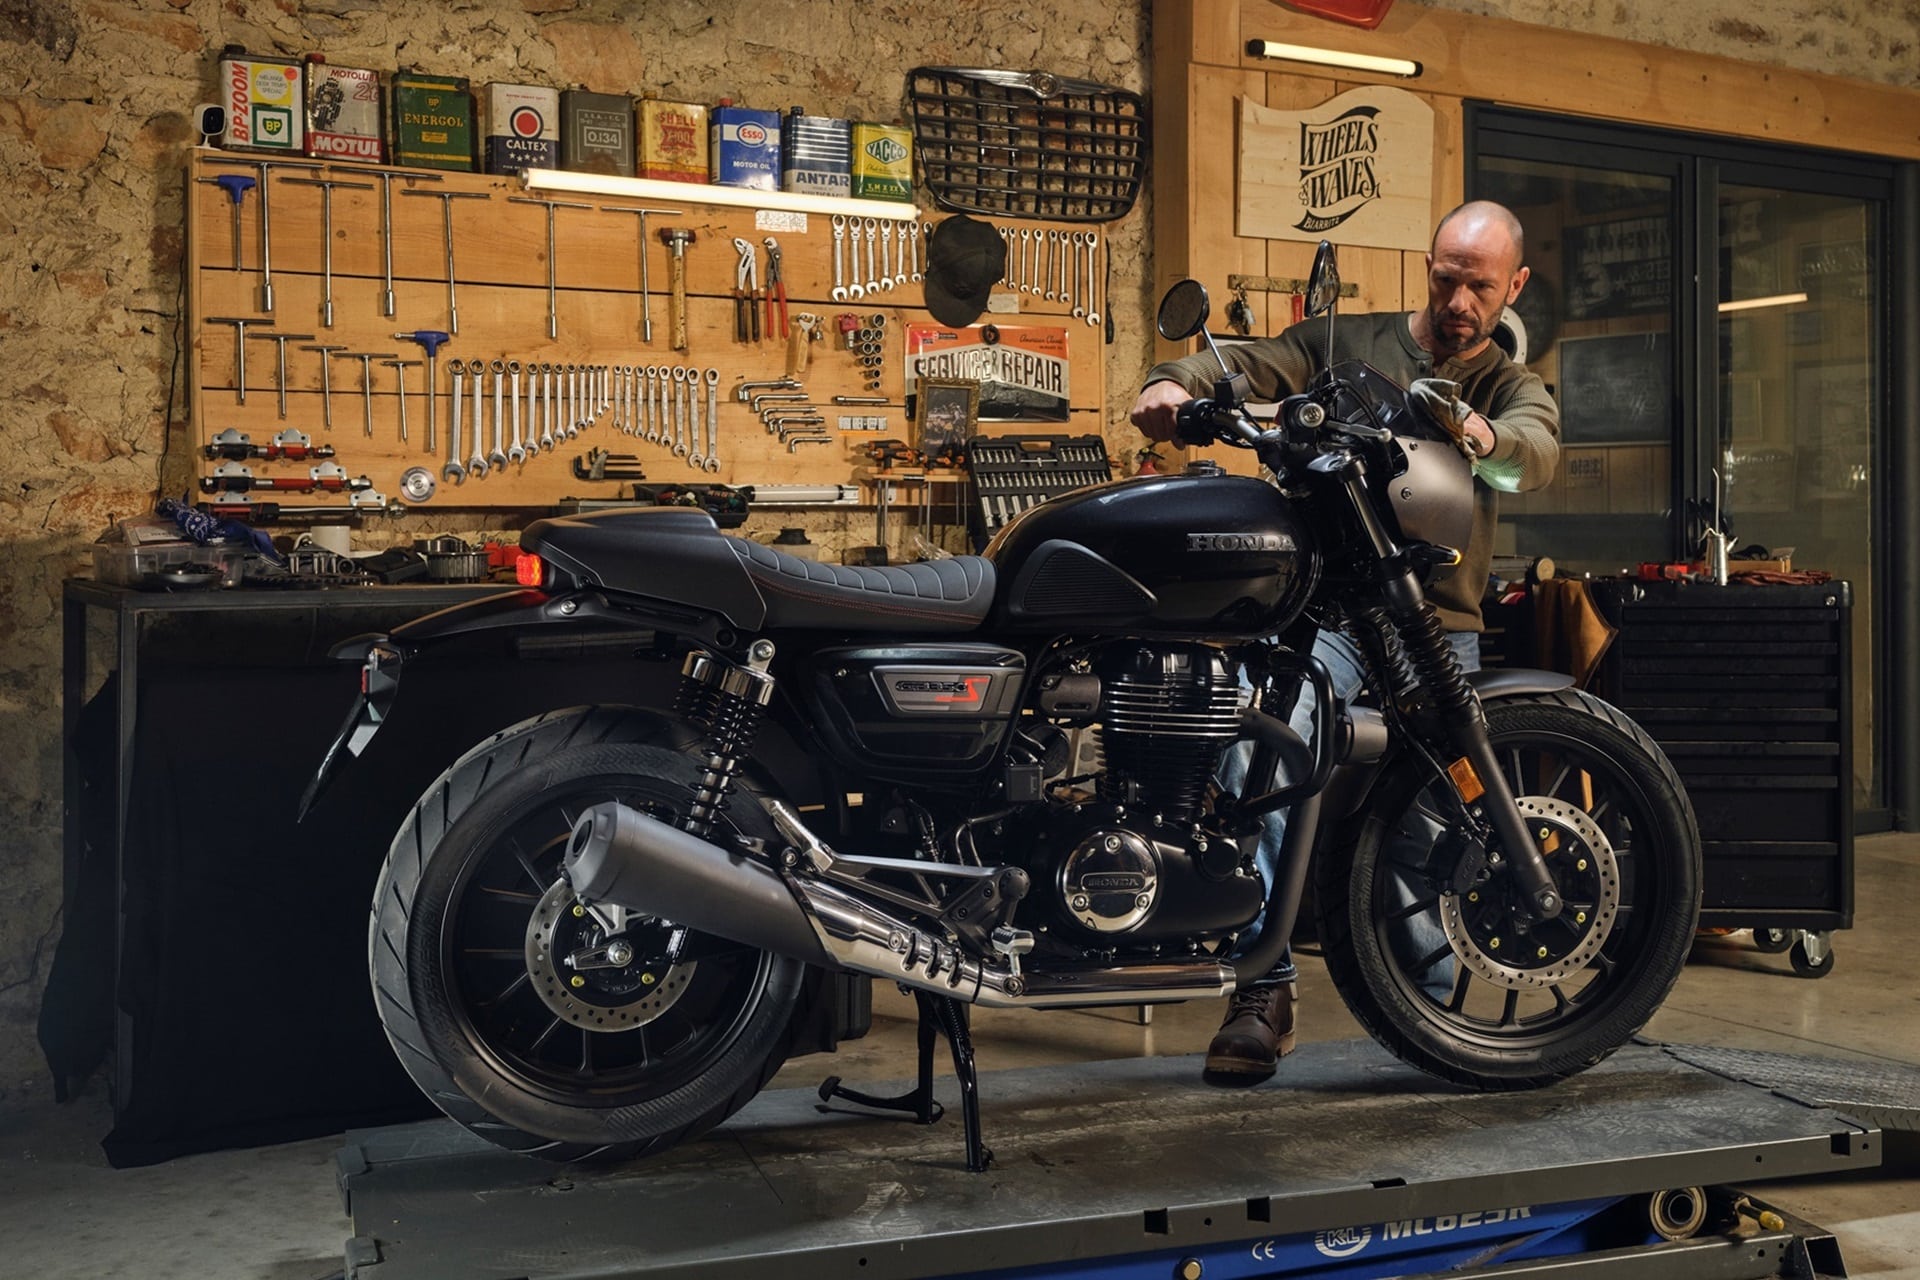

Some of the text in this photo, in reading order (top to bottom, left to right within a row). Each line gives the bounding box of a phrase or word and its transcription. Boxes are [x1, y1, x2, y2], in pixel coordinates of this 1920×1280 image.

[266, 121, 281, 132] BP
[404, 113, 464, 128] ENERGOL
[660, 111, 697, 127] SHELL
[313, 135, 380, 157] MOTUL
[506, 140, 548, 152] CALTEX
[1300, 120, 1379, 166] WHEELS
[869, 140, 904, 162] YACCO
[733, 161, 758, 169] MOTOR
[796, 172, 849, 187] ANTAR
[1298, 155, 1381, 209] & WAVES
[1303, 217, 1341, 231] BIARRITZ
[1001, 349, 1062, 393] REPAIR
[1187, 533, 1297, 552] HONDA
[1088, 878, 1139, 887] HONDA
